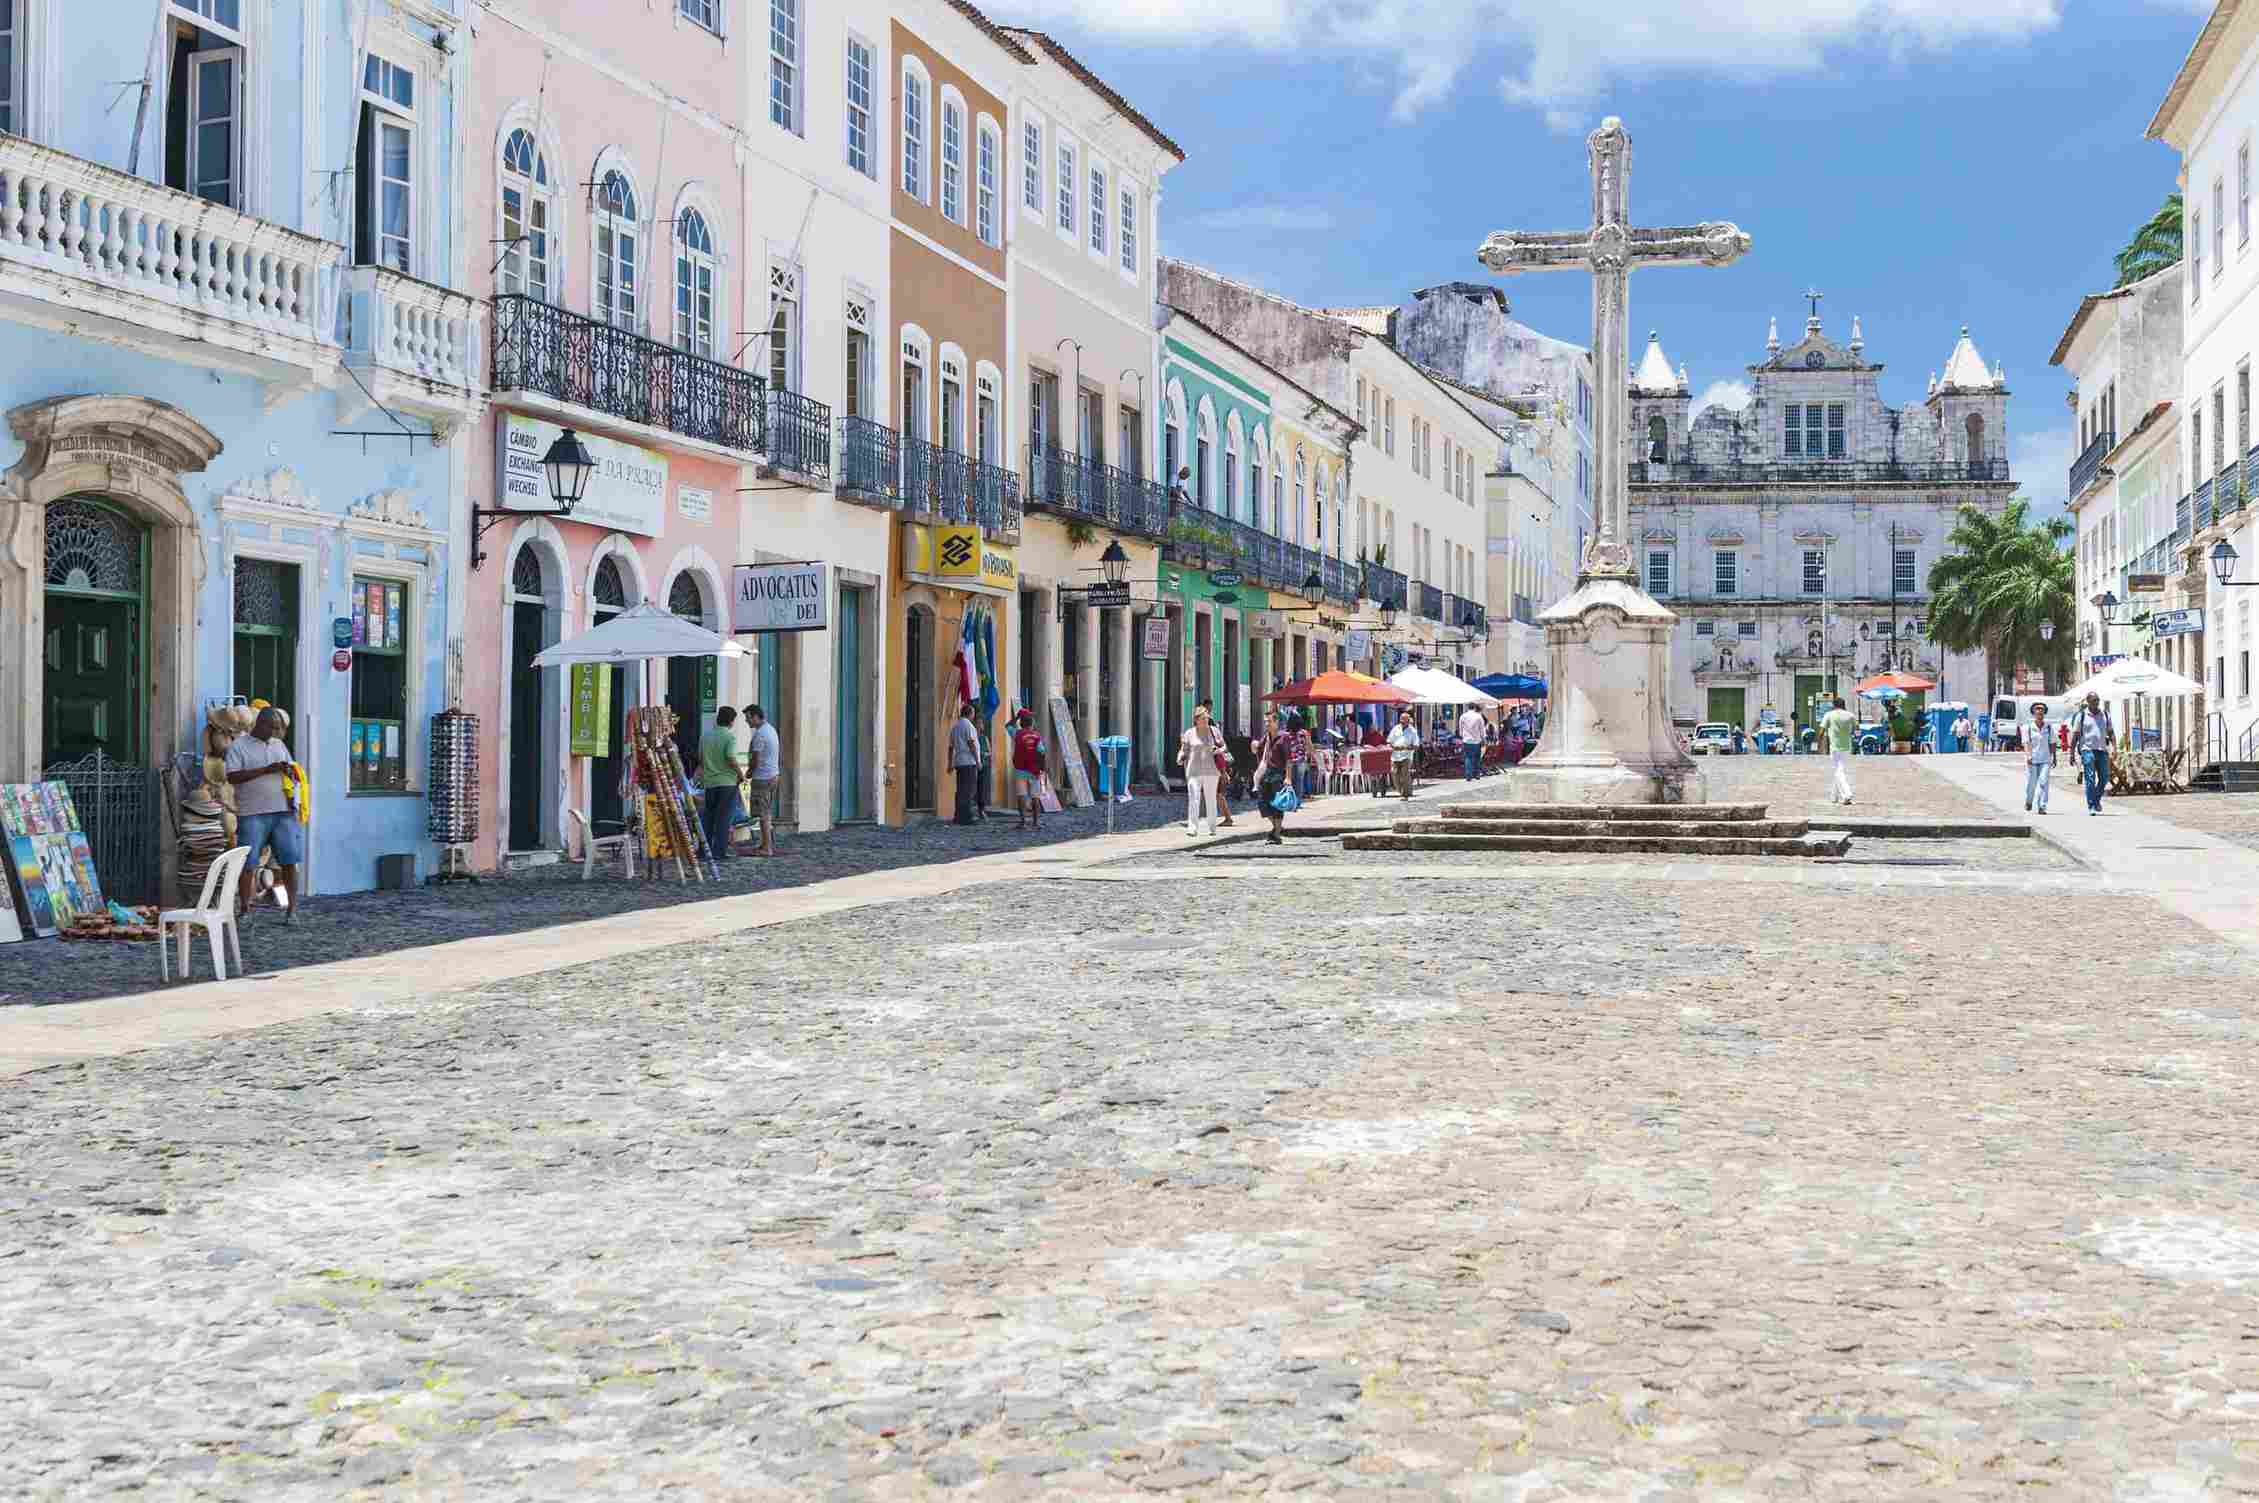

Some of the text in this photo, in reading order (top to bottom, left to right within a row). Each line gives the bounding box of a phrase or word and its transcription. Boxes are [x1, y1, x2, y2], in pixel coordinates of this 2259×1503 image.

[508, 479, 538, 497] WECHSEL
[740, 573, 818, 602] ADVOCATUS
[796, 603, 817, 620] DEI
